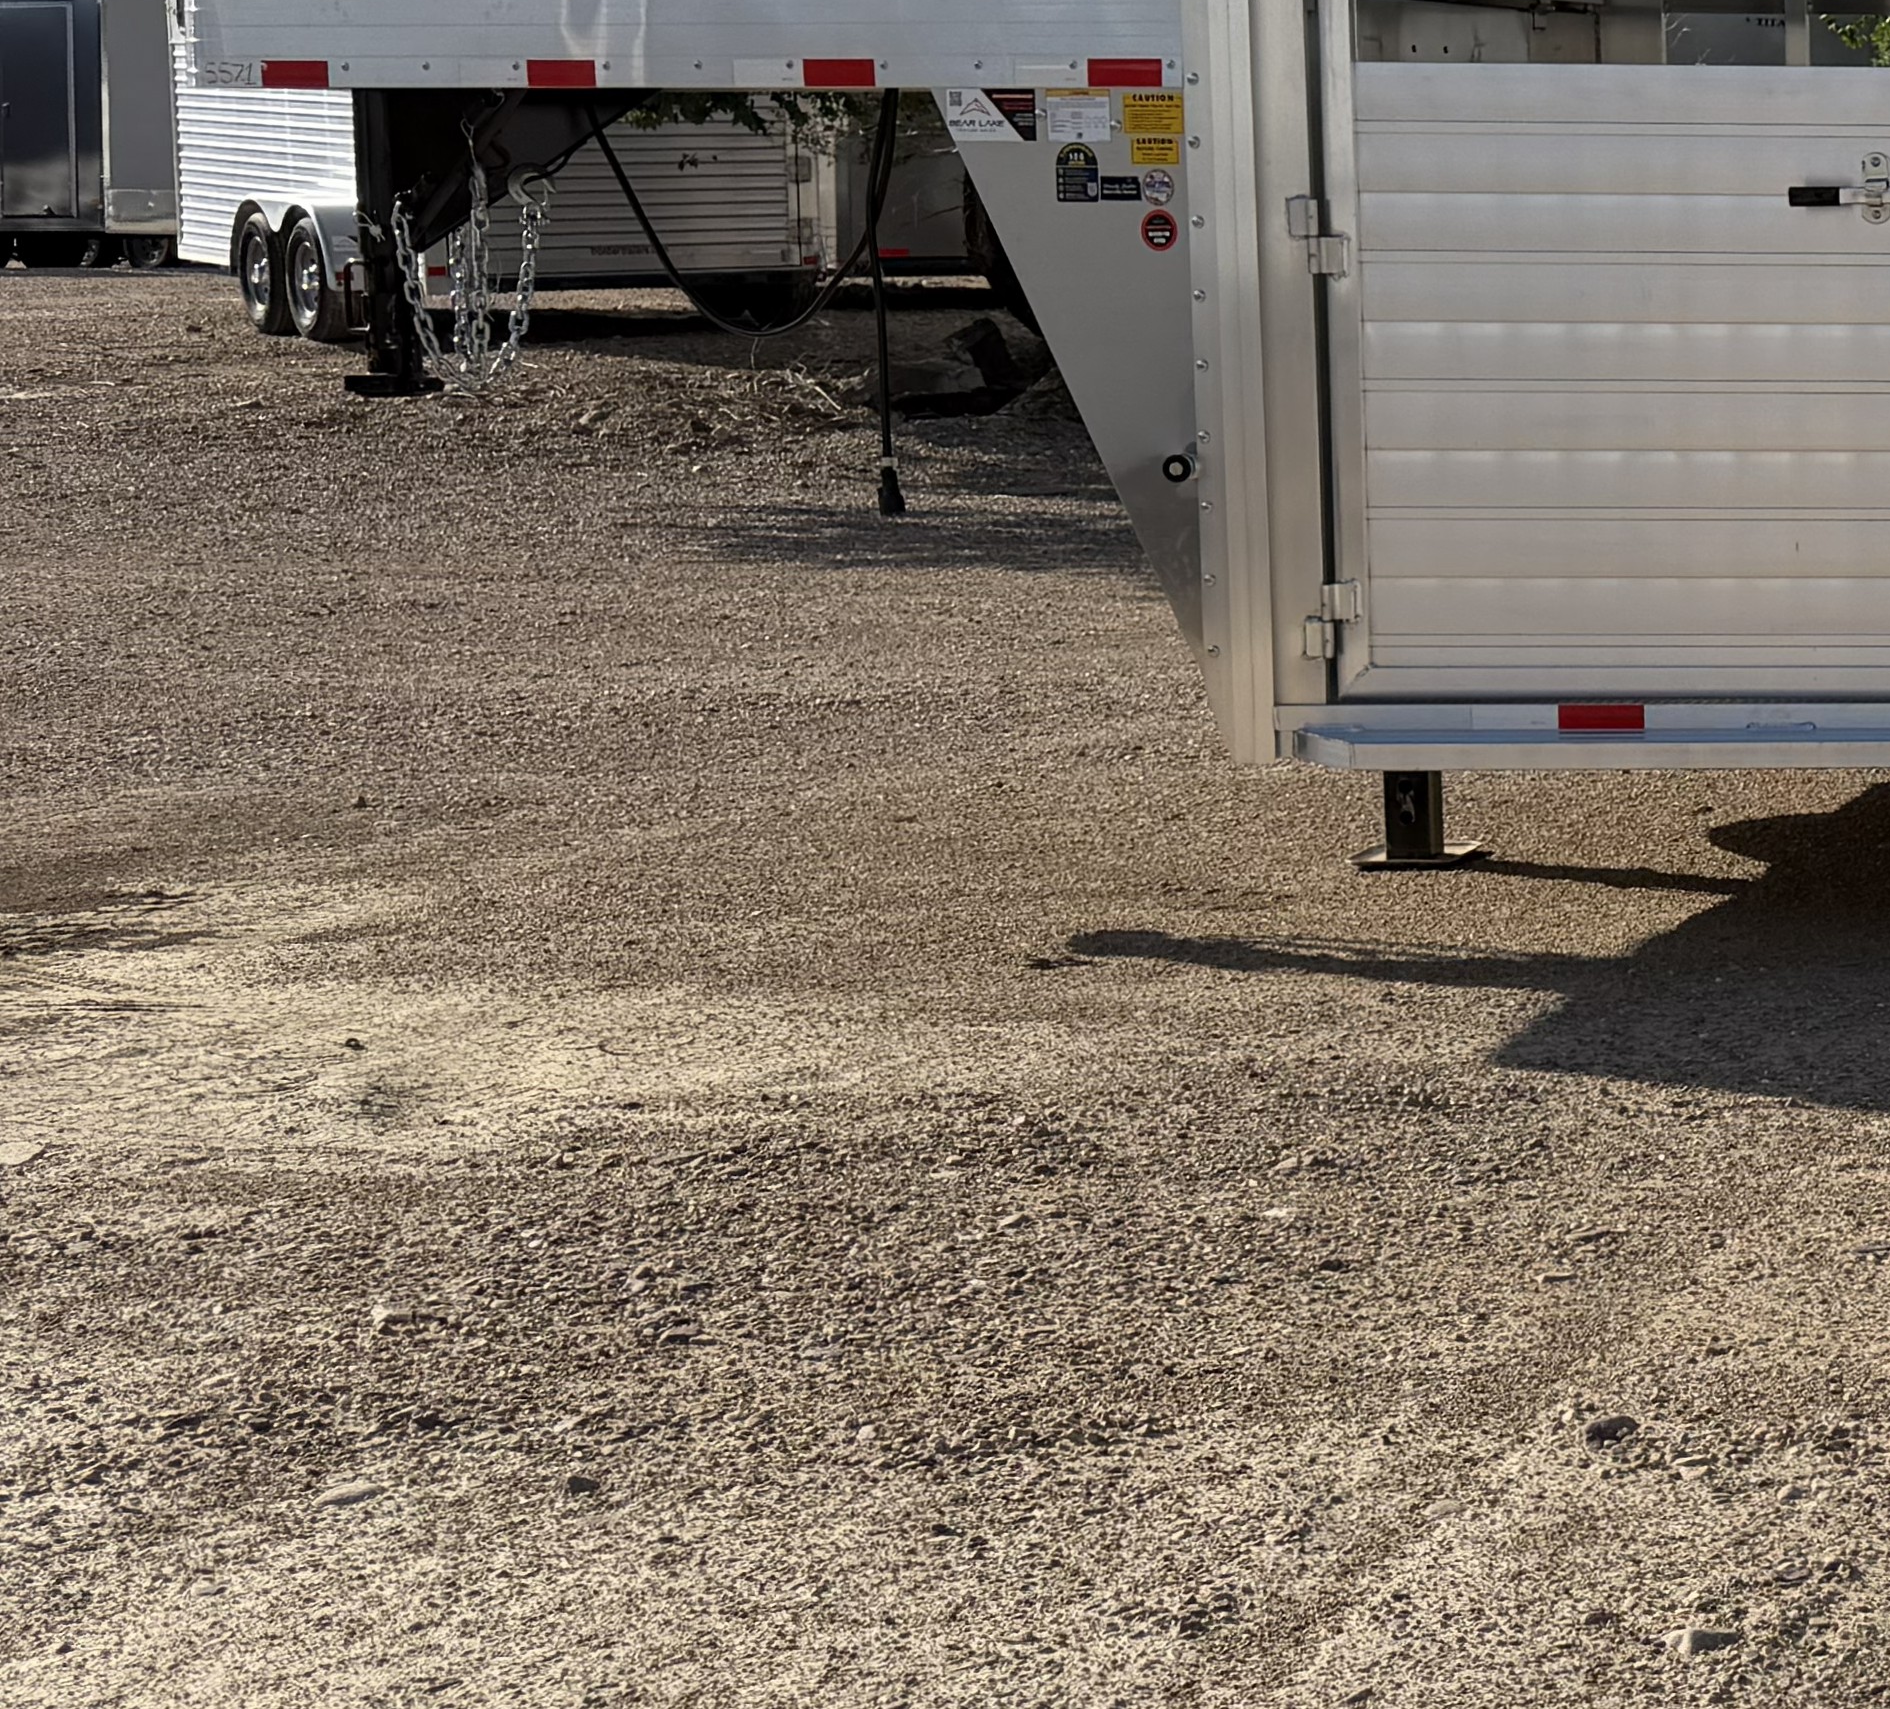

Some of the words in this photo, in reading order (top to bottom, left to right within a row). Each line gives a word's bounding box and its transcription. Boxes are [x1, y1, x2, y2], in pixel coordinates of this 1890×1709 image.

[1756, 17, 1786, 28] TITA
[1132, 93, 1174, 102] CAUTION
[978, 119, 1005, 128] LAKE
[1136, 137, 1174, 145] CAUTION
